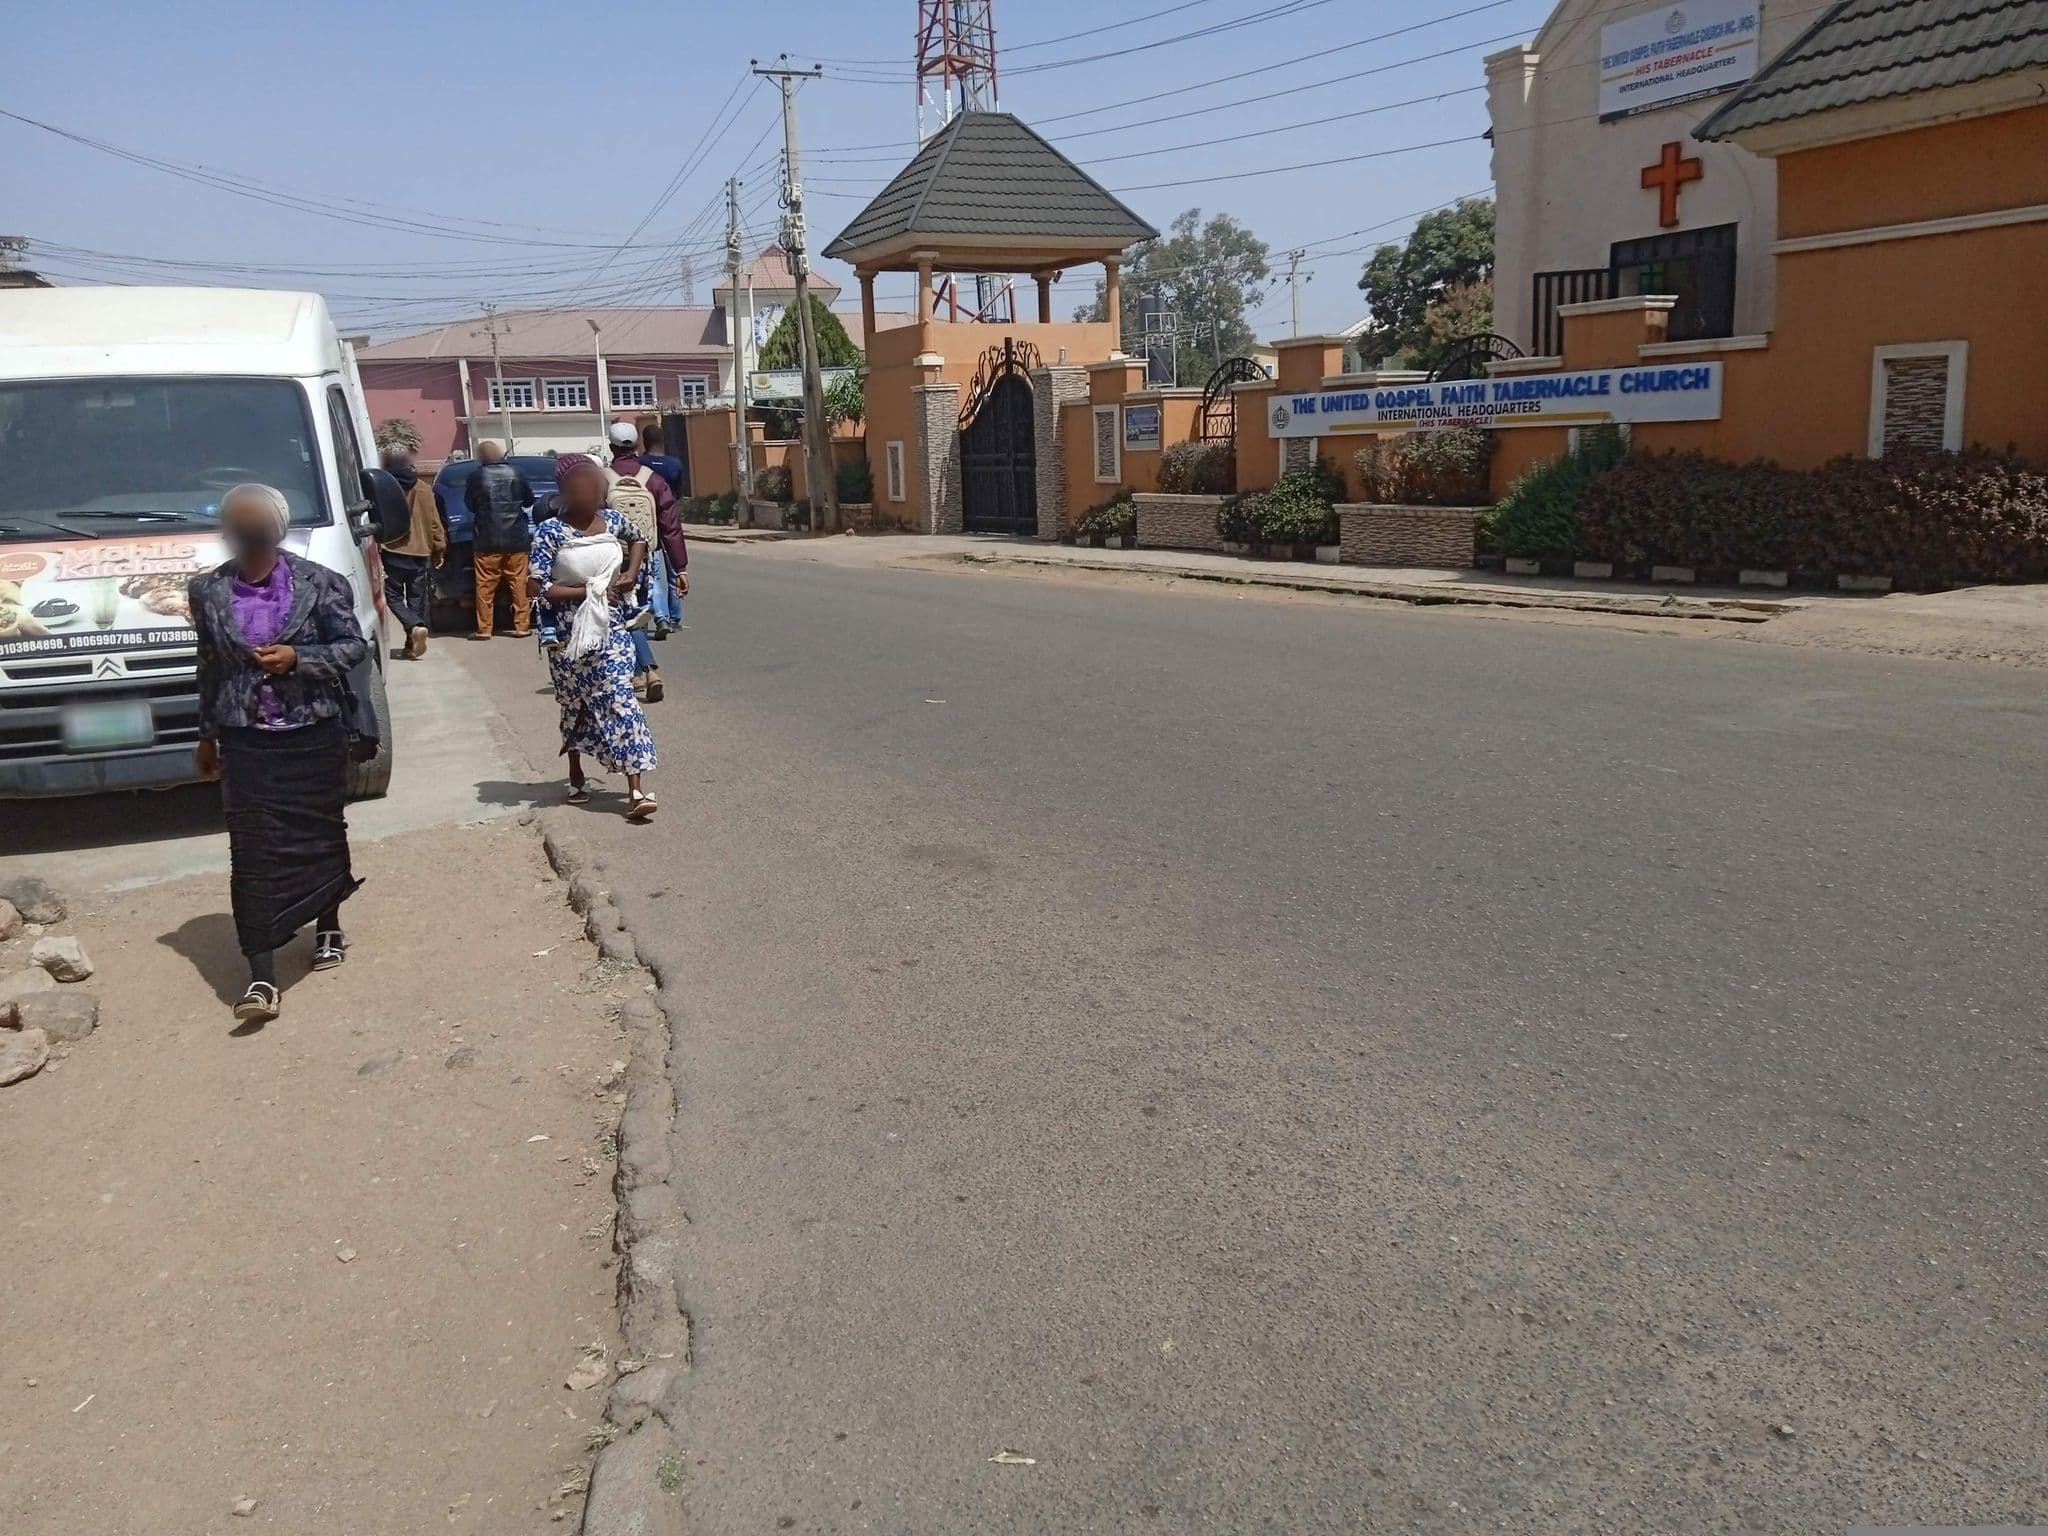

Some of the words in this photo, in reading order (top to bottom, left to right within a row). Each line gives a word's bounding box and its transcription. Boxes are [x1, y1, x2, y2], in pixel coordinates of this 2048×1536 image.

[1634, 64, 1651, 76] HIS
[1654, 47, 1714, 71] TABERNACLE
[1619, 73, 1674, 93] INTERNATIONAL
[1676, 56, 1736, 78] HEADQUARTERS
[1292, 398, 1316, 414] THE
[1321, 393, 1369, 413] UNITED
[1375, 387, 1433, 408] GOSPEL
[1440, 383, 1486, 405] FAITH
[1492, 374, 1611, 401] TABERNACLE
[1619, 367, 1711, 394] CHURCH
[1377, 406, 1453, 421] INTERNATIONAL
[1457, 401, 1541, 417] HEADQUARTERS
[1418, 419, 1435, 428] (HIS
[1438, 417, 1492, 427] TABERNACLE)
[61, 543, 196, 562] Mobile
[58, 559, 199, 580] Kitchen
